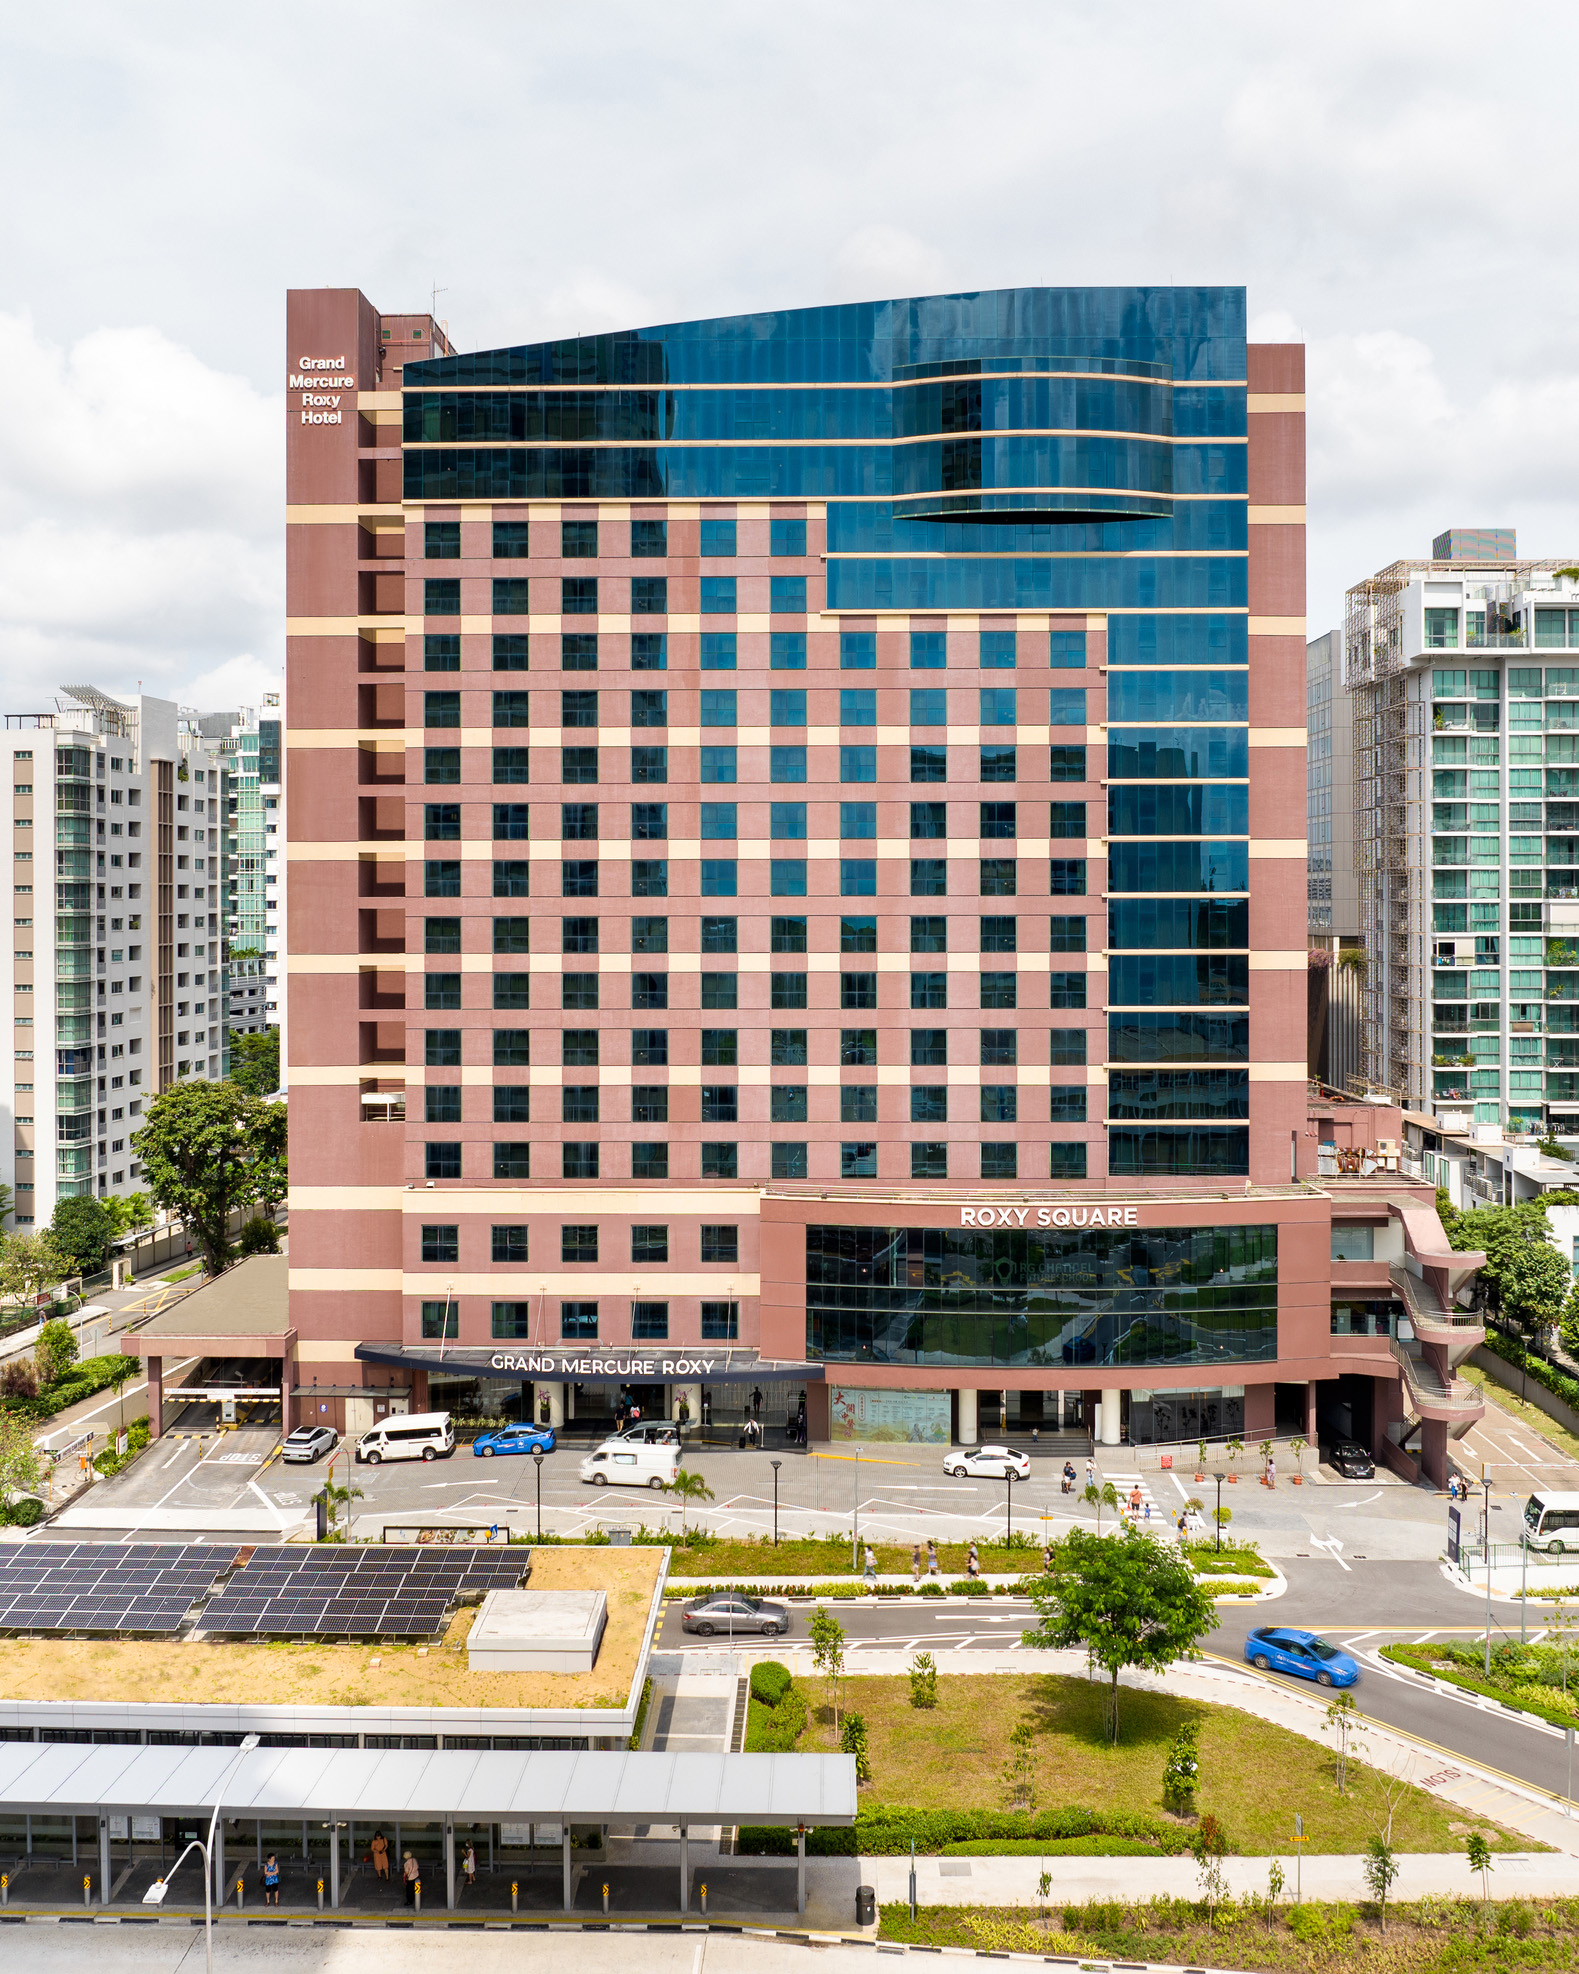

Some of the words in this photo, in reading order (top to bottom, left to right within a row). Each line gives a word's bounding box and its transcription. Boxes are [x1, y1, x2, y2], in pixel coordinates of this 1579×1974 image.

[299, 356, 345, 370] Grand
[289, 374, 354, 389] Mercure
[302, 393, 341, 408] Roxy
[301, 411, 342, 425] Hotel
[960, 1207, 1030, 1227] ROXY
[1037, 1207, 1138, 1227] SQUARE
[491, 1354, 555, 1373] GRAND
[561, 1358, 655, 1375] MERCURE
[662, 1359, 715, 1375] ROXY
[219, 1453, 261, 1461] STOP
[1419, 1770, 1461, 1788] SLOW
